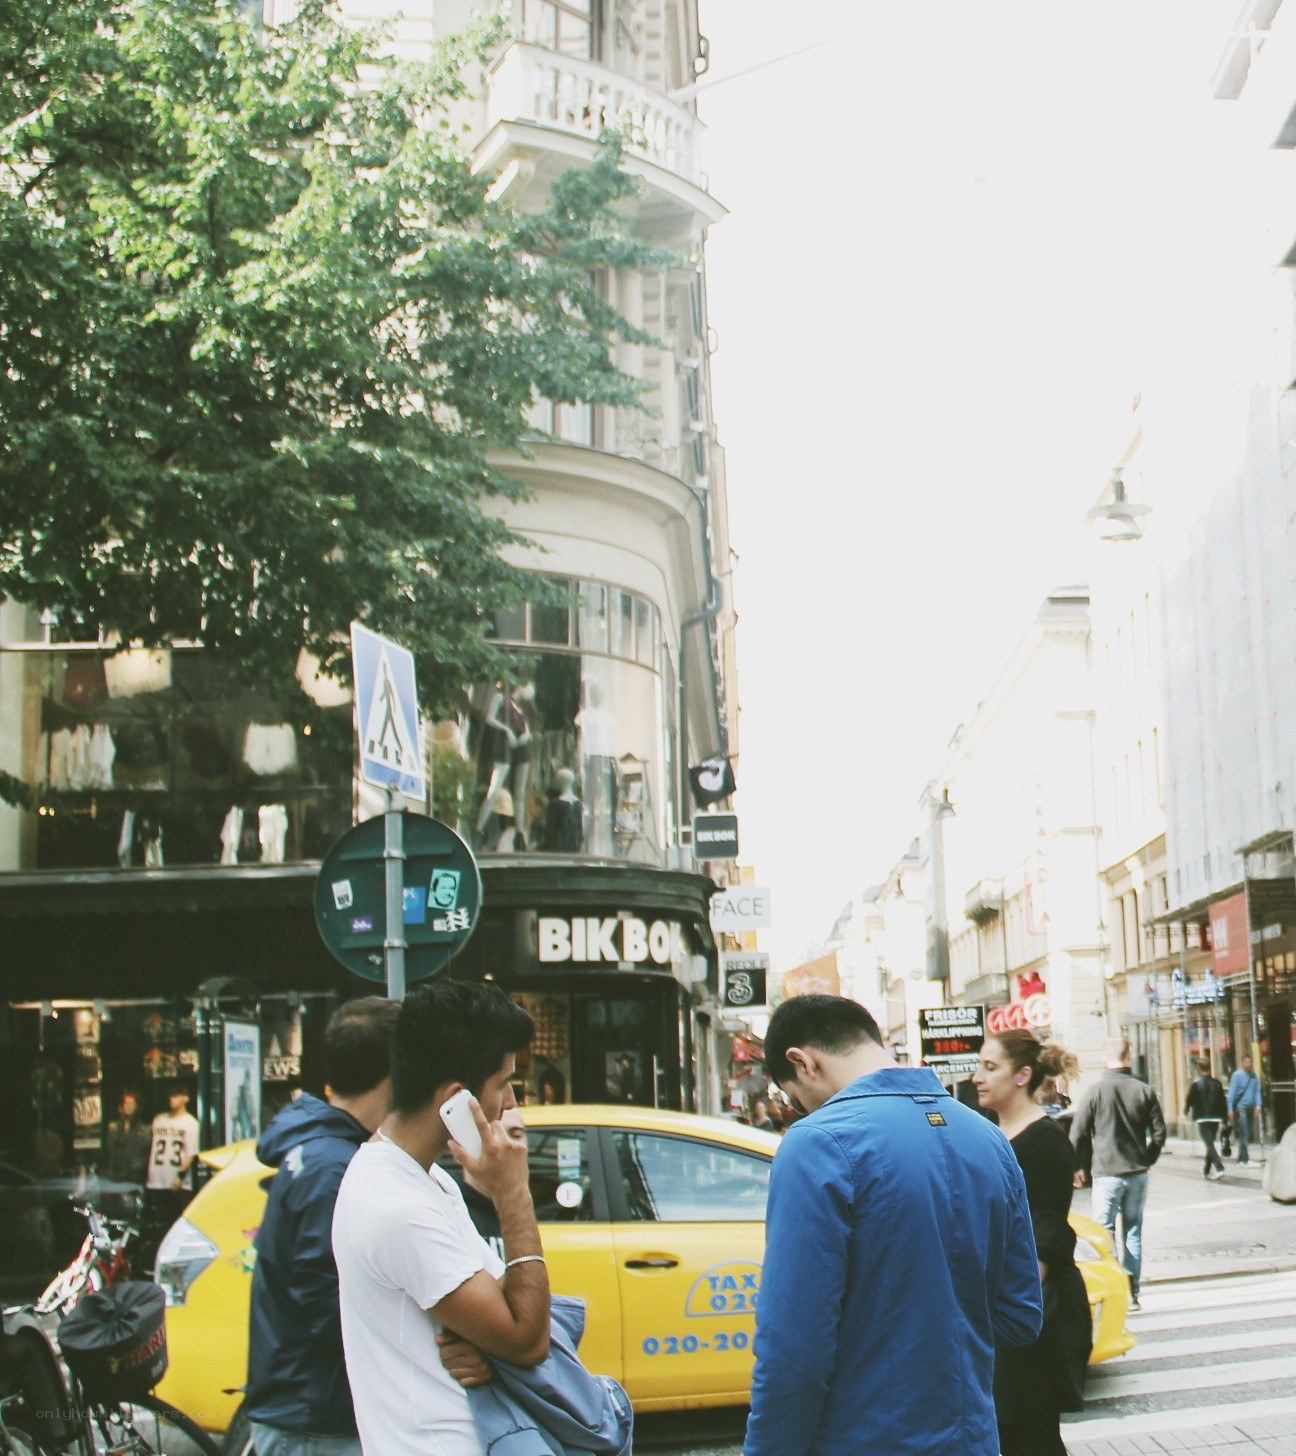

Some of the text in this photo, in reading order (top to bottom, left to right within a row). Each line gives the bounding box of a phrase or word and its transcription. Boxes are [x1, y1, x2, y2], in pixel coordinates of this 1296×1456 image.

[712, 897, 763, 917] FACE
[538, 917, 621, 963] BIK
[154, 1139, 184, 1167] 23
[708, 1274, 758, 1291] TAX
[642, 1332, 749, 1356] 020-20
